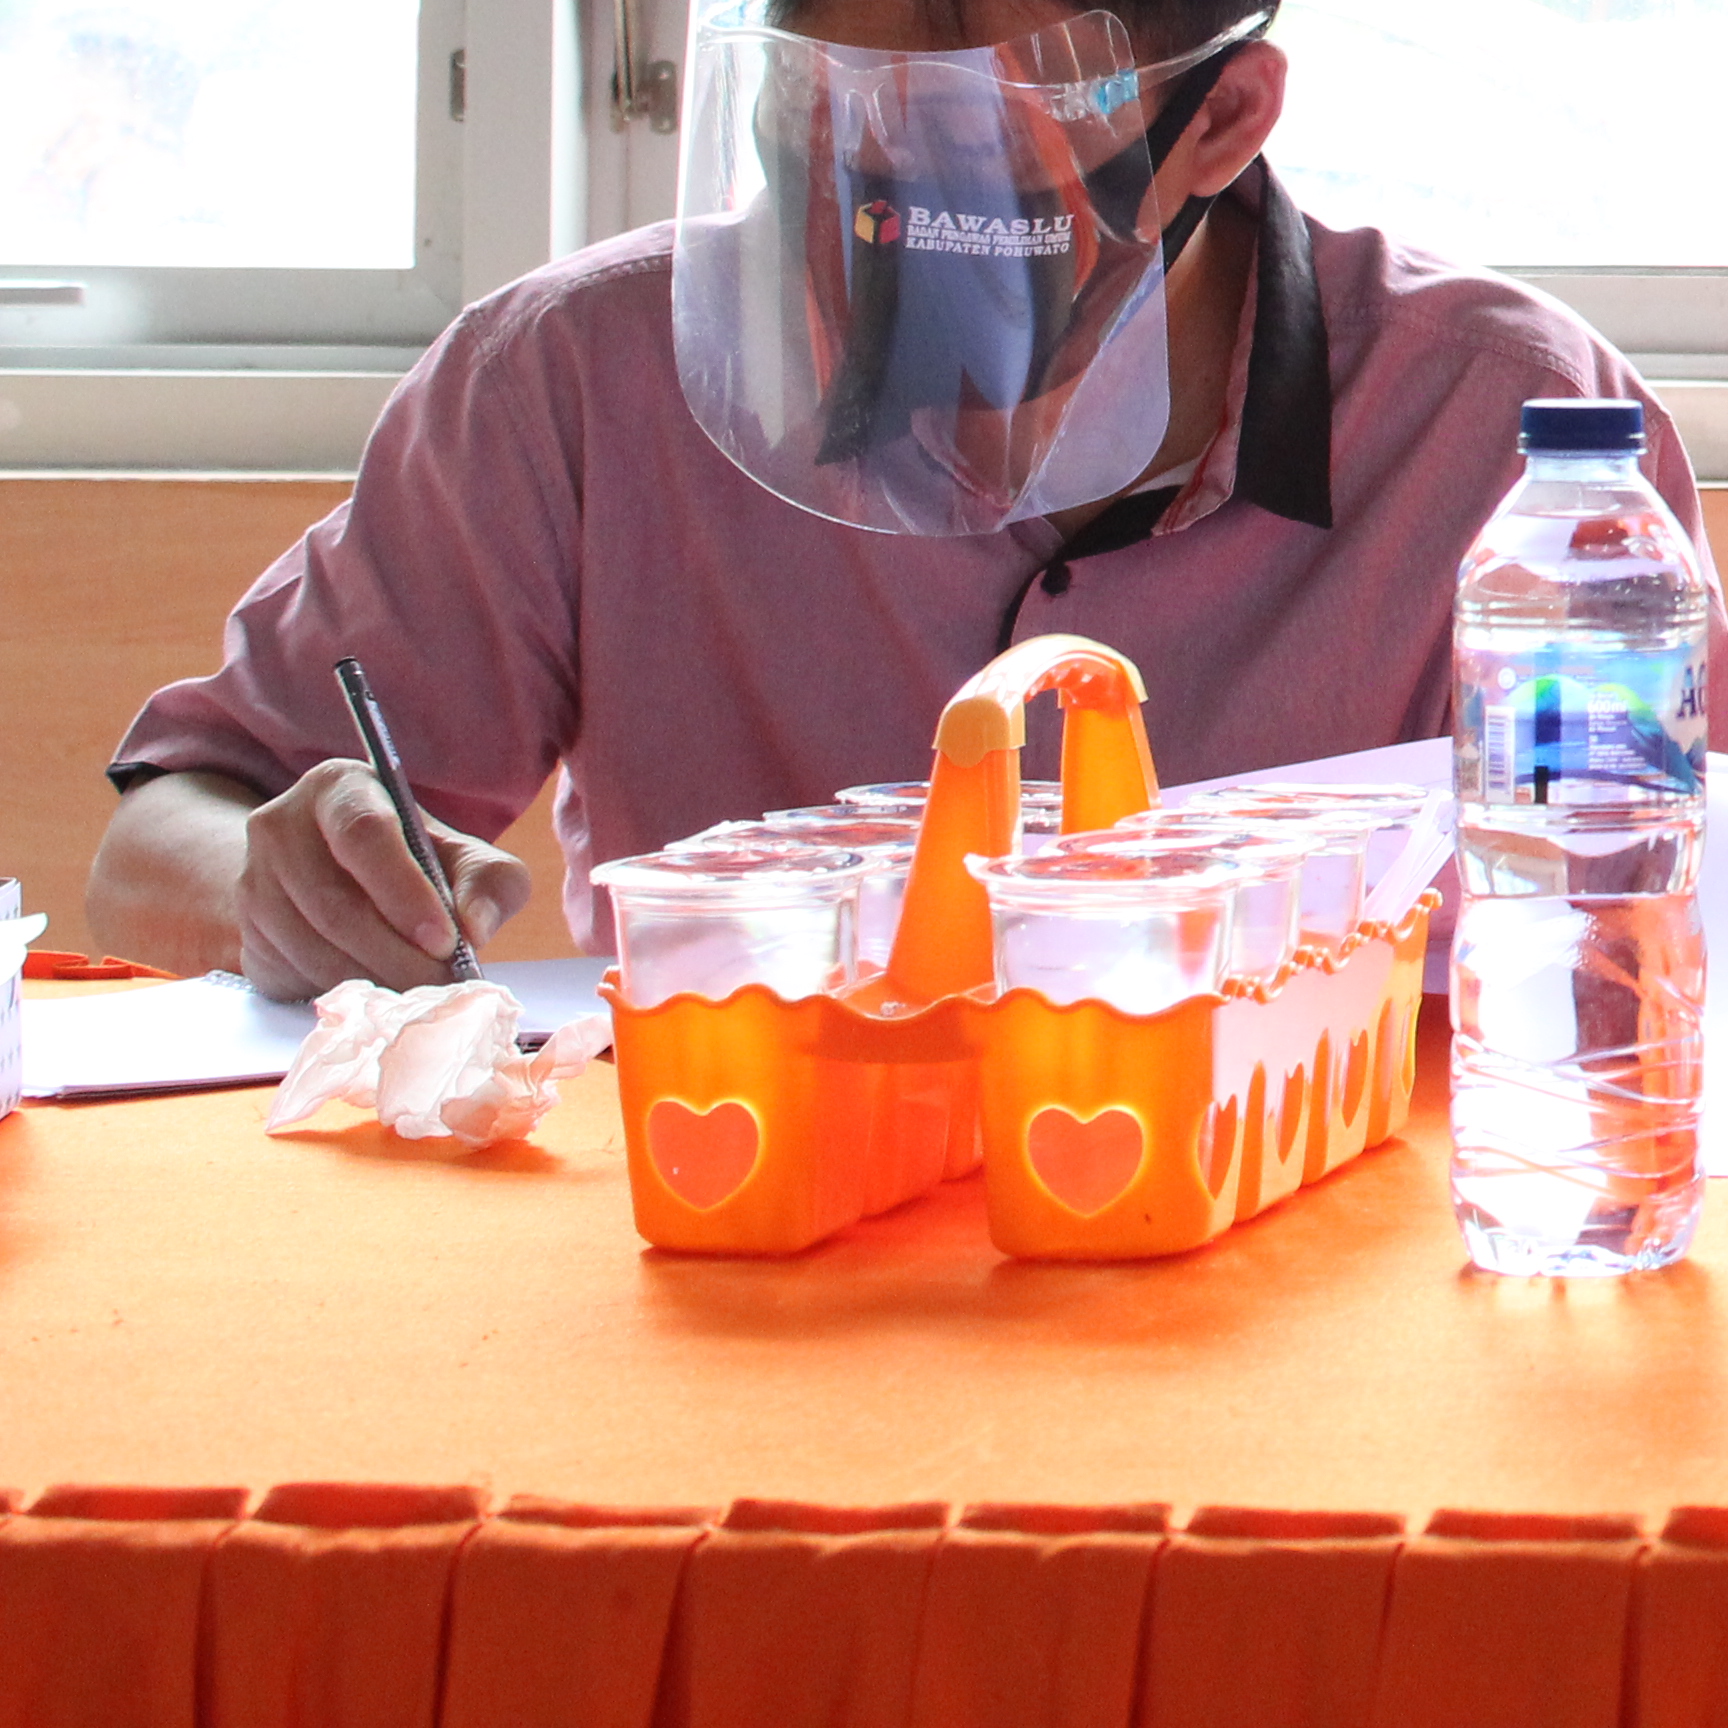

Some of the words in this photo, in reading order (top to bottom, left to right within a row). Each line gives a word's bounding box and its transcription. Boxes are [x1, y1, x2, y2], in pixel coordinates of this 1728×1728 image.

[908, 206, 1075, 235] BAWASLU
[905, 237, 991, 256] KABUPATEN
[994, 243, 1070, 258] POHUWATO
